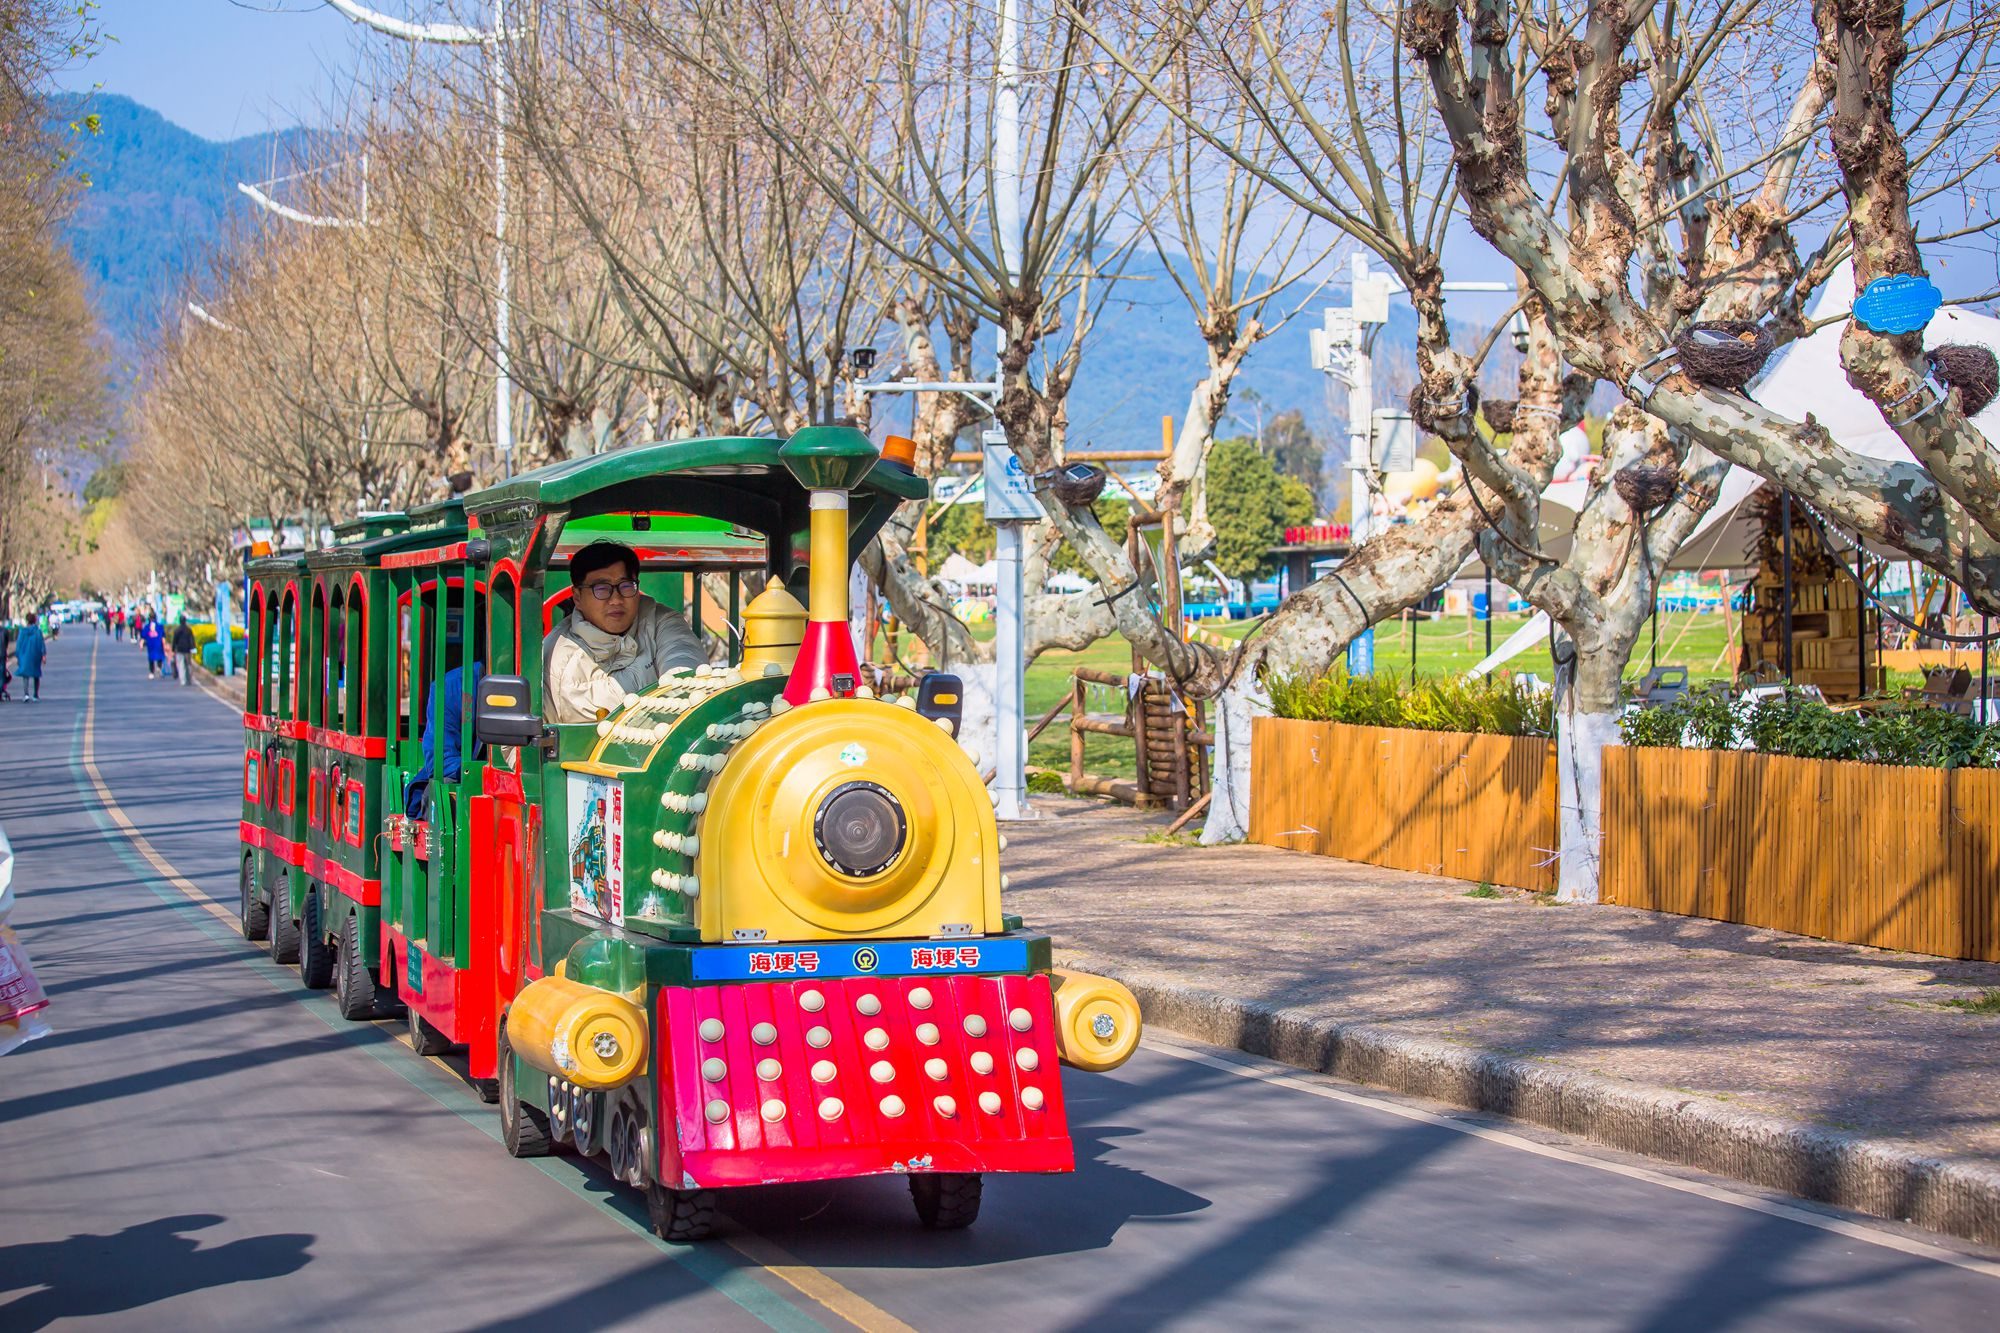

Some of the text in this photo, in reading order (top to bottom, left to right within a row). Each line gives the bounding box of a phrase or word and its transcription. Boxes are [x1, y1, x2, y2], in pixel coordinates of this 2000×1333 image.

[612, 787, 622, 918] 海埂号
[751, 952, 818, 972] 海埂号
[912, 949, 980, 968] 海埂号
